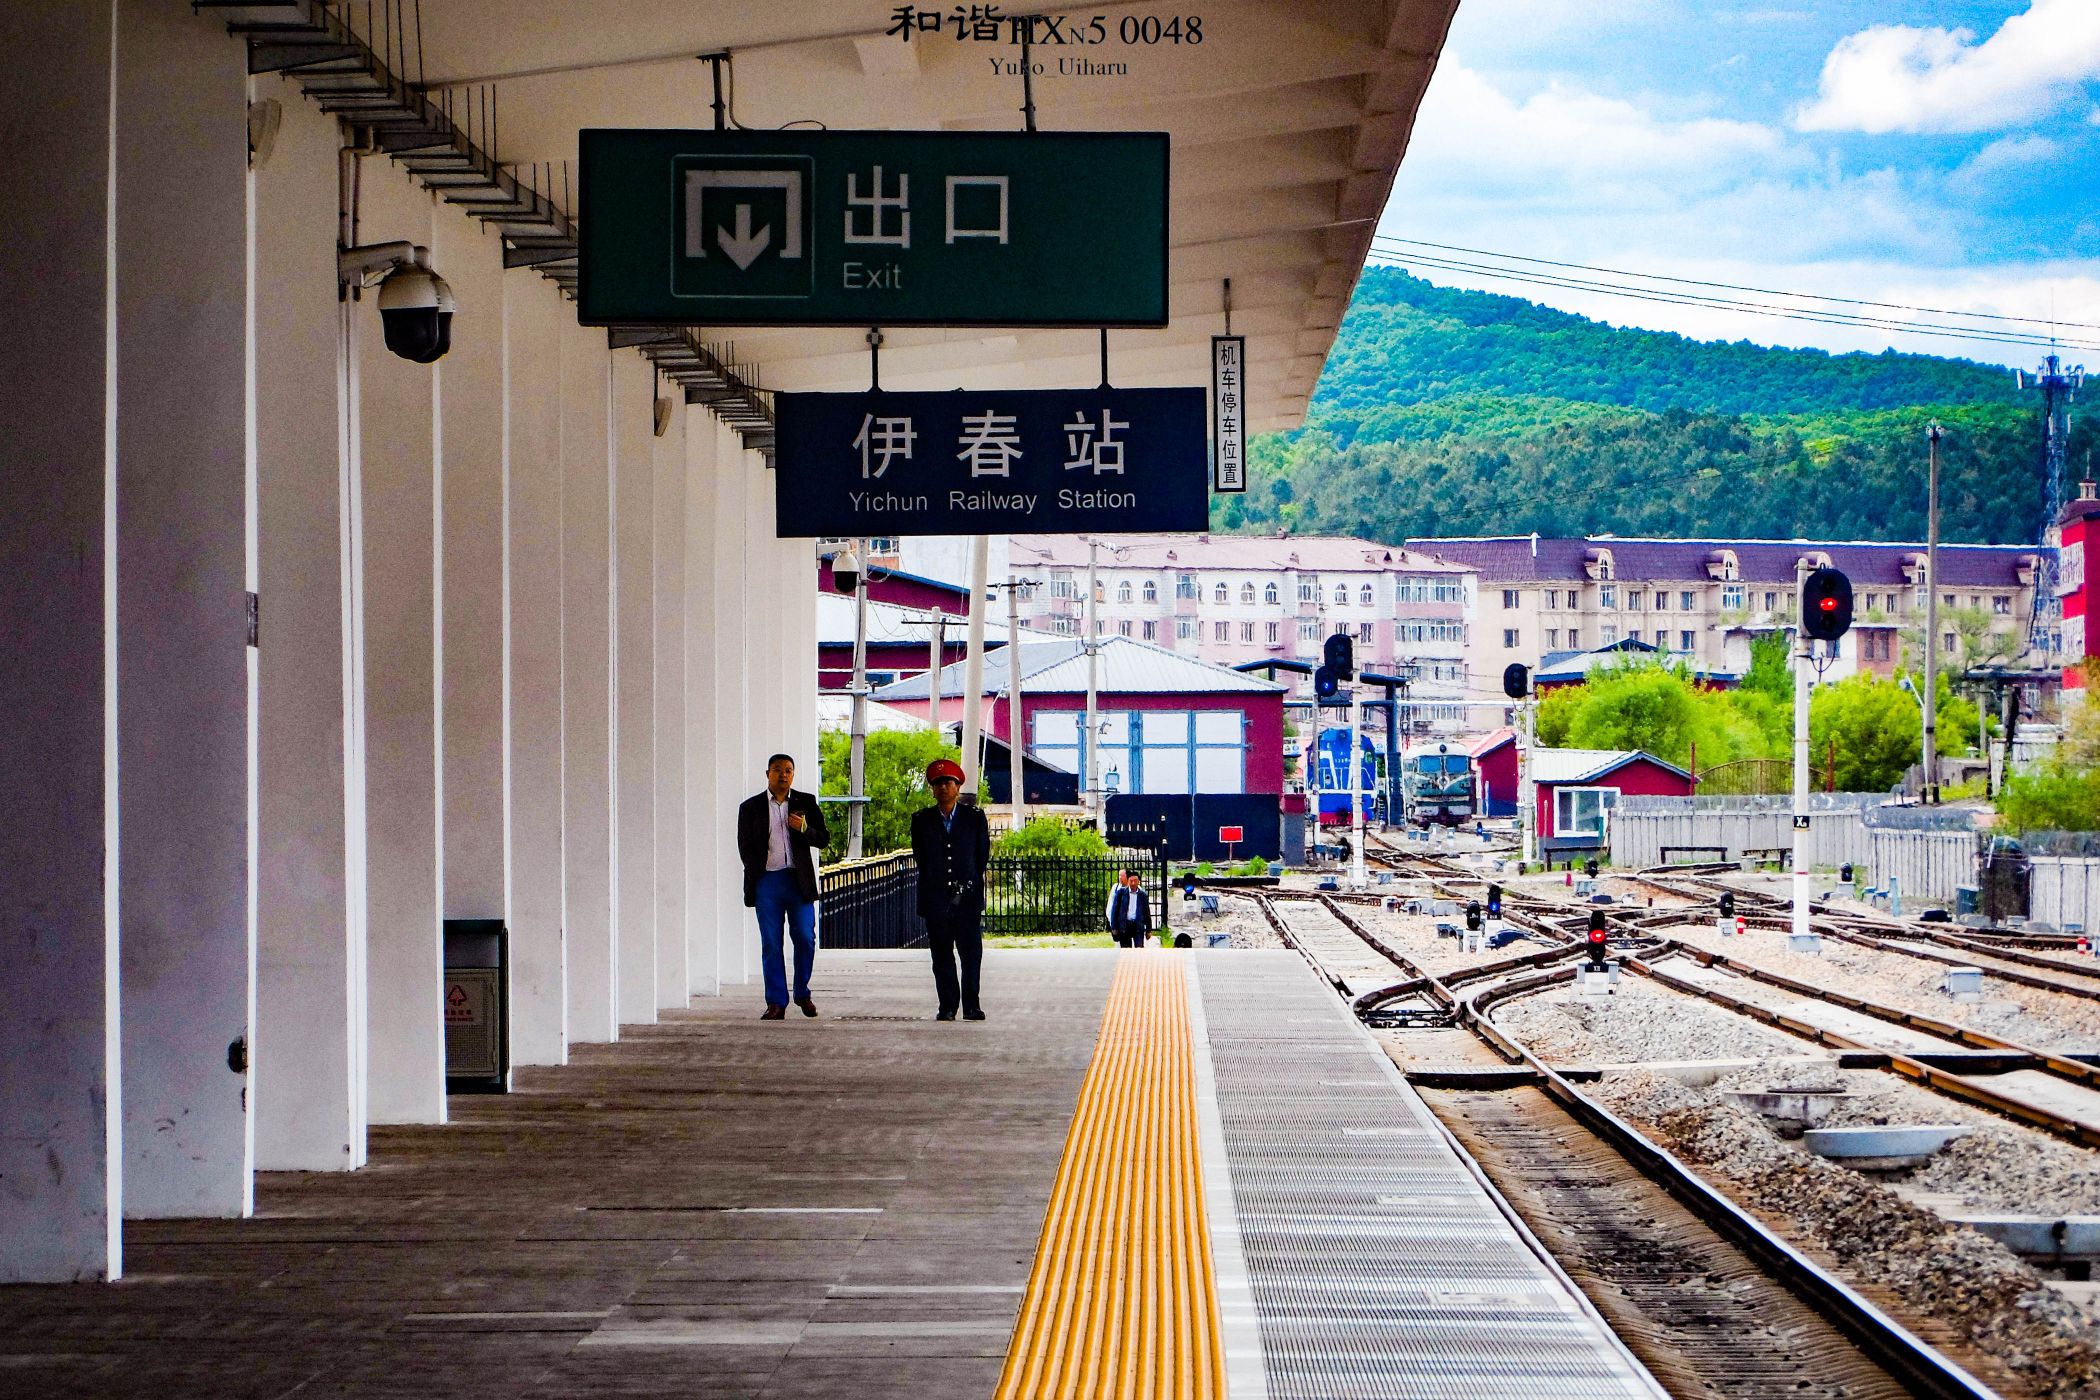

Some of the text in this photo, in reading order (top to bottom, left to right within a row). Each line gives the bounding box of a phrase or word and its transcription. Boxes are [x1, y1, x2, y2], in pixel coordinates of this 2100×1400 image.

[844, 165, 1009, 249] 出口
[843, 261, 902, 289] Exit
[852, 408, 1130, 479] 伊春站
[1220, 344, 1238, 484] 机车停车位置
[849, 488, 1136, 515] Yichun Railway Station
